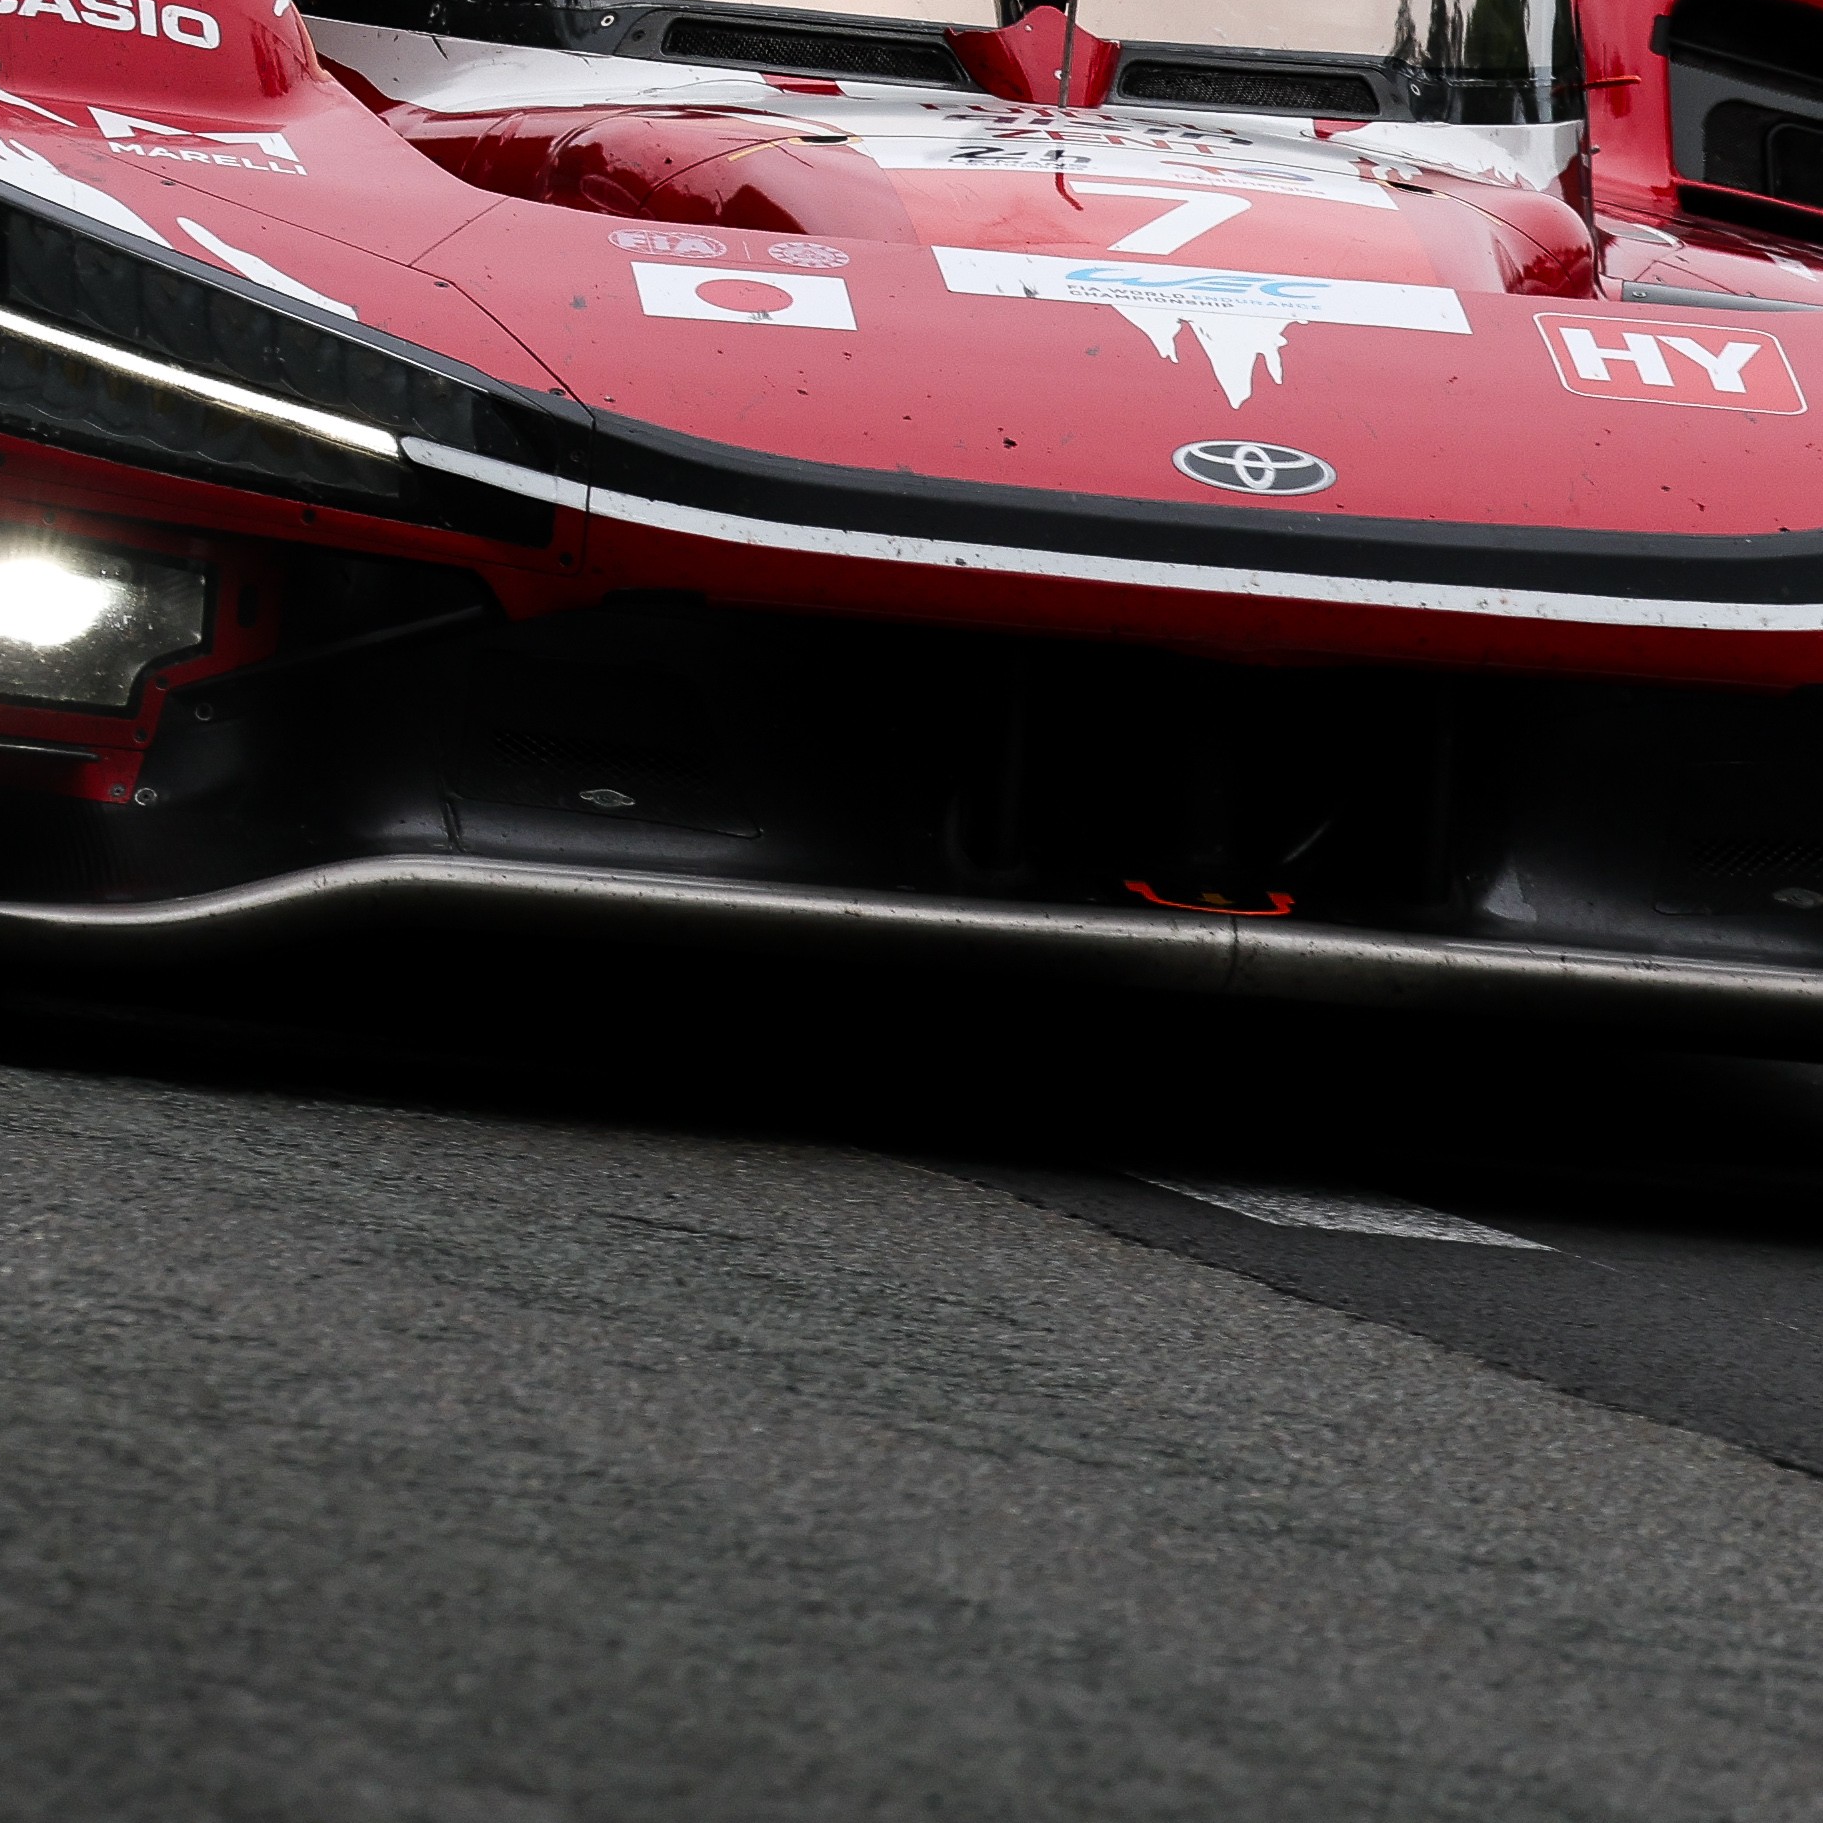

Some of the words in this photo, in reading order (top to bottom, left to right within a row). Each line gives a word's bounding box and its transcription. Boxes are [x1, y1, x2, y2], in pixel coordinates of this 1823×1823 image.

[985, 127, 1231, 154] ZENT
[108, 140, 308, 176] MARELLI
[1070, 180, 1252, 255] 7
[617, 231, 717, 256] FIA
[1069, 290, 1235, 308] CHAMPIONSHIP
[1108, 288, 1185, 299] WORLD
[1558, 327, 1762, 394] HY
